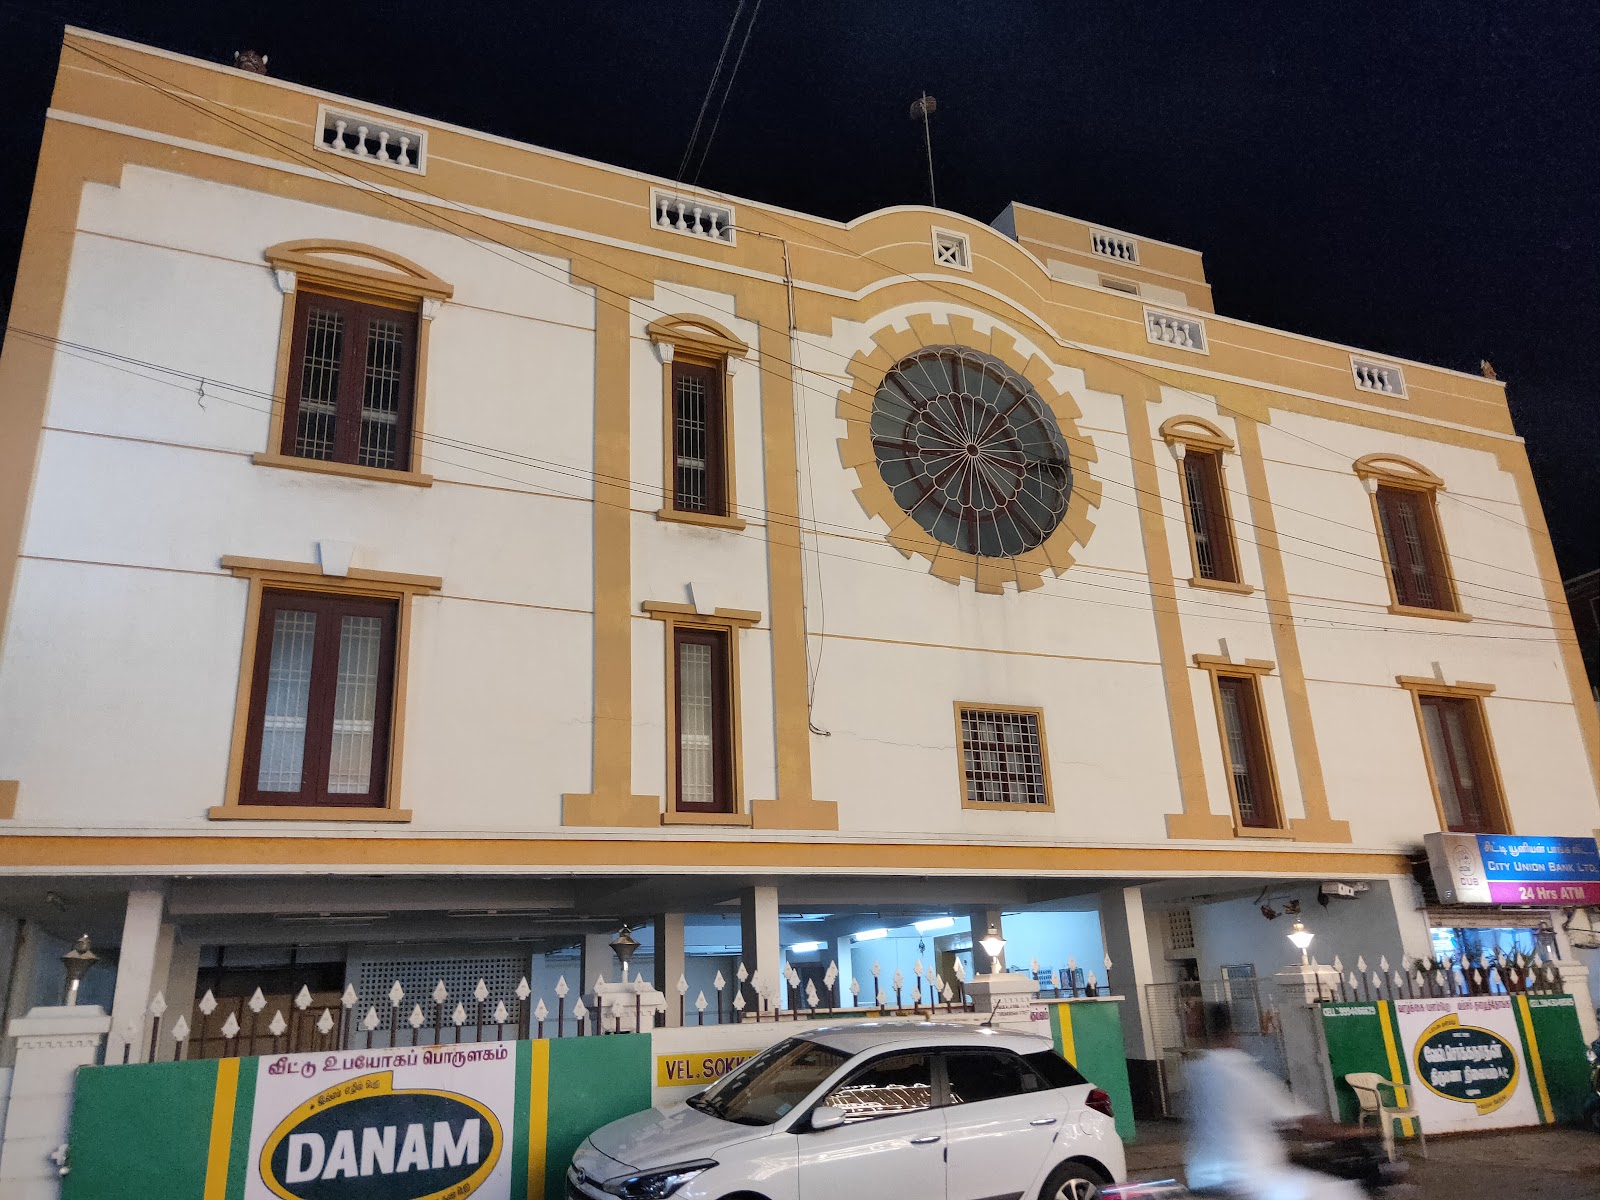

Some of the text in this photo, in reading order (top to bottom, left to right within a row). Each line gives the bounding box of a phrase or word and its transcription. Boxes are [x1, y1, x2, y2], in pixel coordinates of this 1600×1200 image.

[1487, 860, 1510, 871] CITY
[1513, 861, 1545, 872] UNION
[1548, 862, 1575, 873] BANK
[1460, 877, 1479, 886] CUB
[1519, 887, 1585, 900] 24 Hrs ATM
[268, 1044, 508, 1079] வீட்டு உபயோகப் பொருளகம்
[285, 1118, 481, 1184] DANAM
